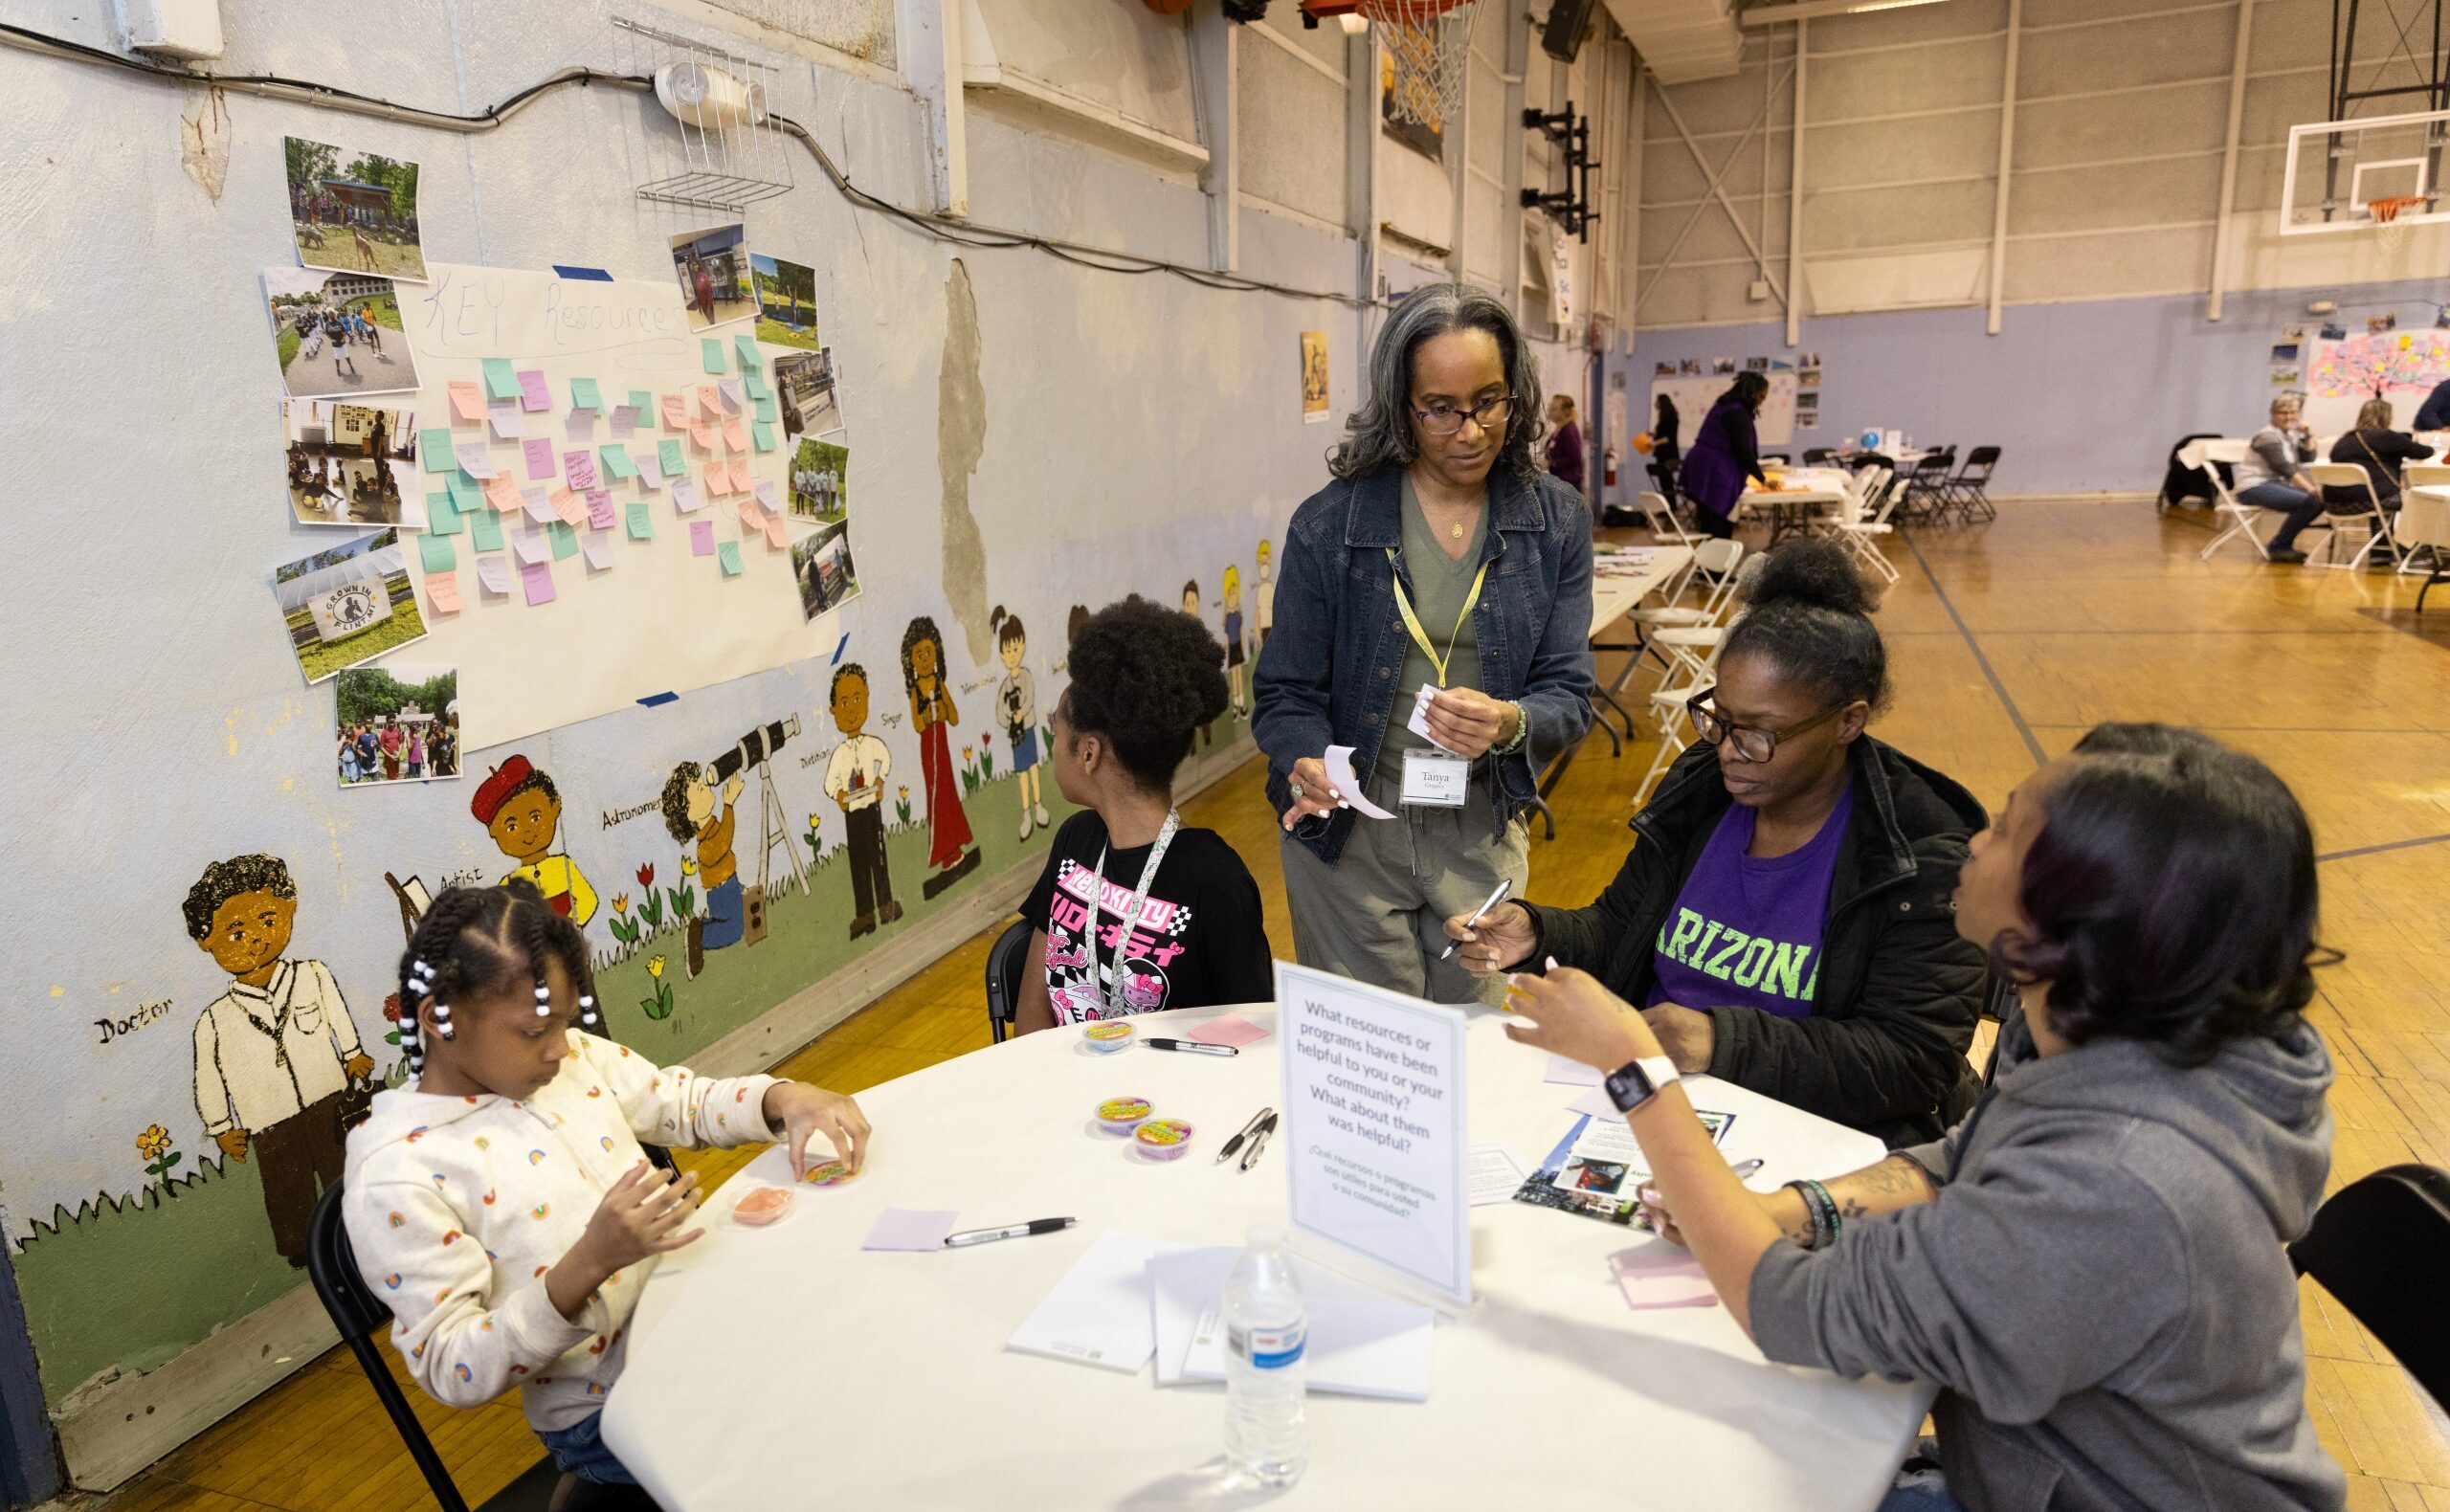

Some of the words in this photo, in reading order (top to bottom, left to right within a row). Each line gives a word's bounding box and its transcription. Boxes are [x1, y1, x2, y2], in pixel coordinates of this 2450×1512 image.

[424, 273, 504, 346] KEY
[545, 282, 686, 345] Resources
[325, 585, 359, 611] GROWN
[362, 586, 371, 596] IN
[1421, 771, 1450, 784] Tanya
[440, 868, 483, 894] Artist
[1655, 906, 1822, 1002] RIZON
[94, 998, 174, 1044] Doctor
[1304, 999, 1342, 1024] What
[1345, 1014, 1412, 1046] resources
[1415, 1037, 1432, 1052] or
[1297, 1039, 1343, 1066] helpful
[1345, 1056, 1360, 1073] to
[1362, 1064, 1389, 1082] you
[1392, 1074, 1407, 1088] or
[1410, 1079, 1443, 1101] your
[1300, 1022, 1363, 1052] programs
[1365, 1040, 1398, 1064] have
[1401, 1052, 1437, 1077] been
[1310, 1084, 1347, 1110] What
[1349, 1101, 1390, 1125] about
[1392, 1116, 1431, 1140] them
[1326, 1073, 1411, 1110] community?
[1327, 1114, 1354, 1133] was
[1357, 1122, 1412, 1154] helpful?
[1323, 1165, 1340, 1178] son
[1341, 1169, 1368, 1189] útiles
[1369, 1184, 1391, 1200] para
[1392, 1190, 1420, 1210] usted
[1333, 1154, 1374, 1177] recursos
[1383, 1174, 1437, 1202] programas
[1340, 1185, 1352, 1196] su
[1352, 1190, 1412, 1219] comunidad?
